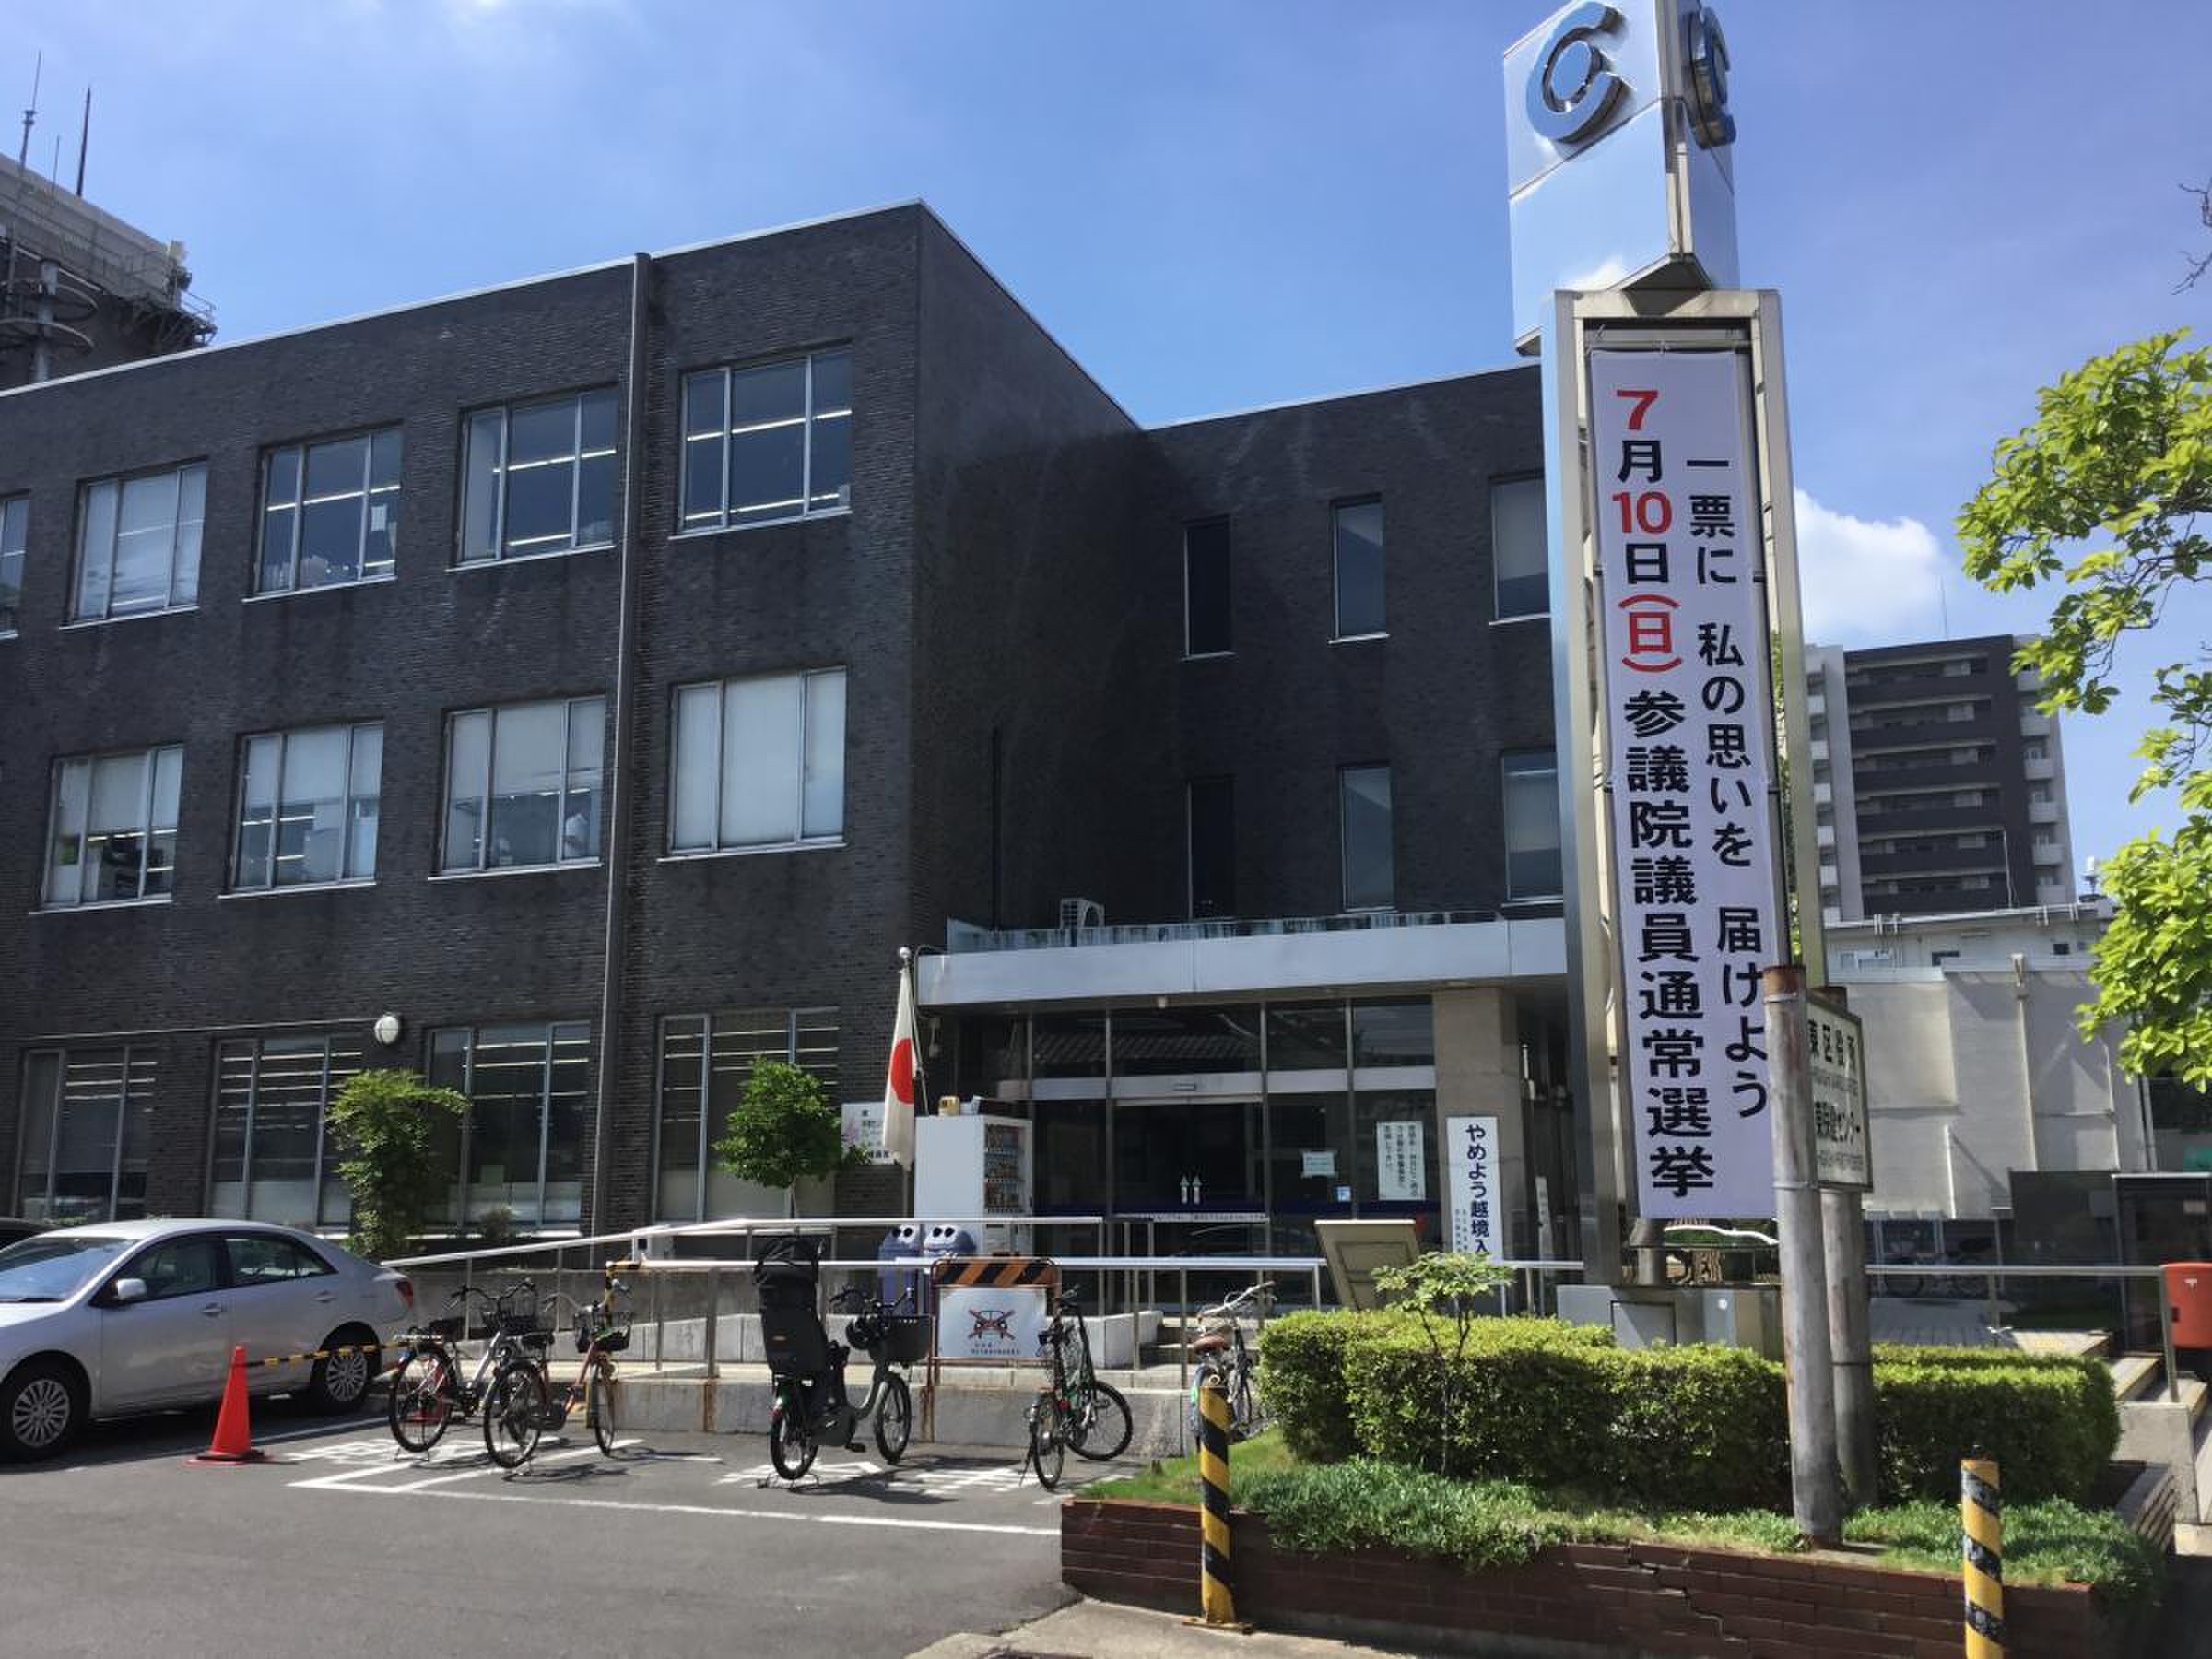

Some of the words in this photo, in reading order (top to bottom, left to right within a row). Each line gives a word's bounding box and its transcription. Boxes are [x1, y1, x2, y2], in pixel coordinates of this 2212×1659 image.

[1686, 459, 1737, 586] 一票に
[1697, 622, 1752, 867] 私の思いを
[1716, 907, 1768, 1119] 届けよう
